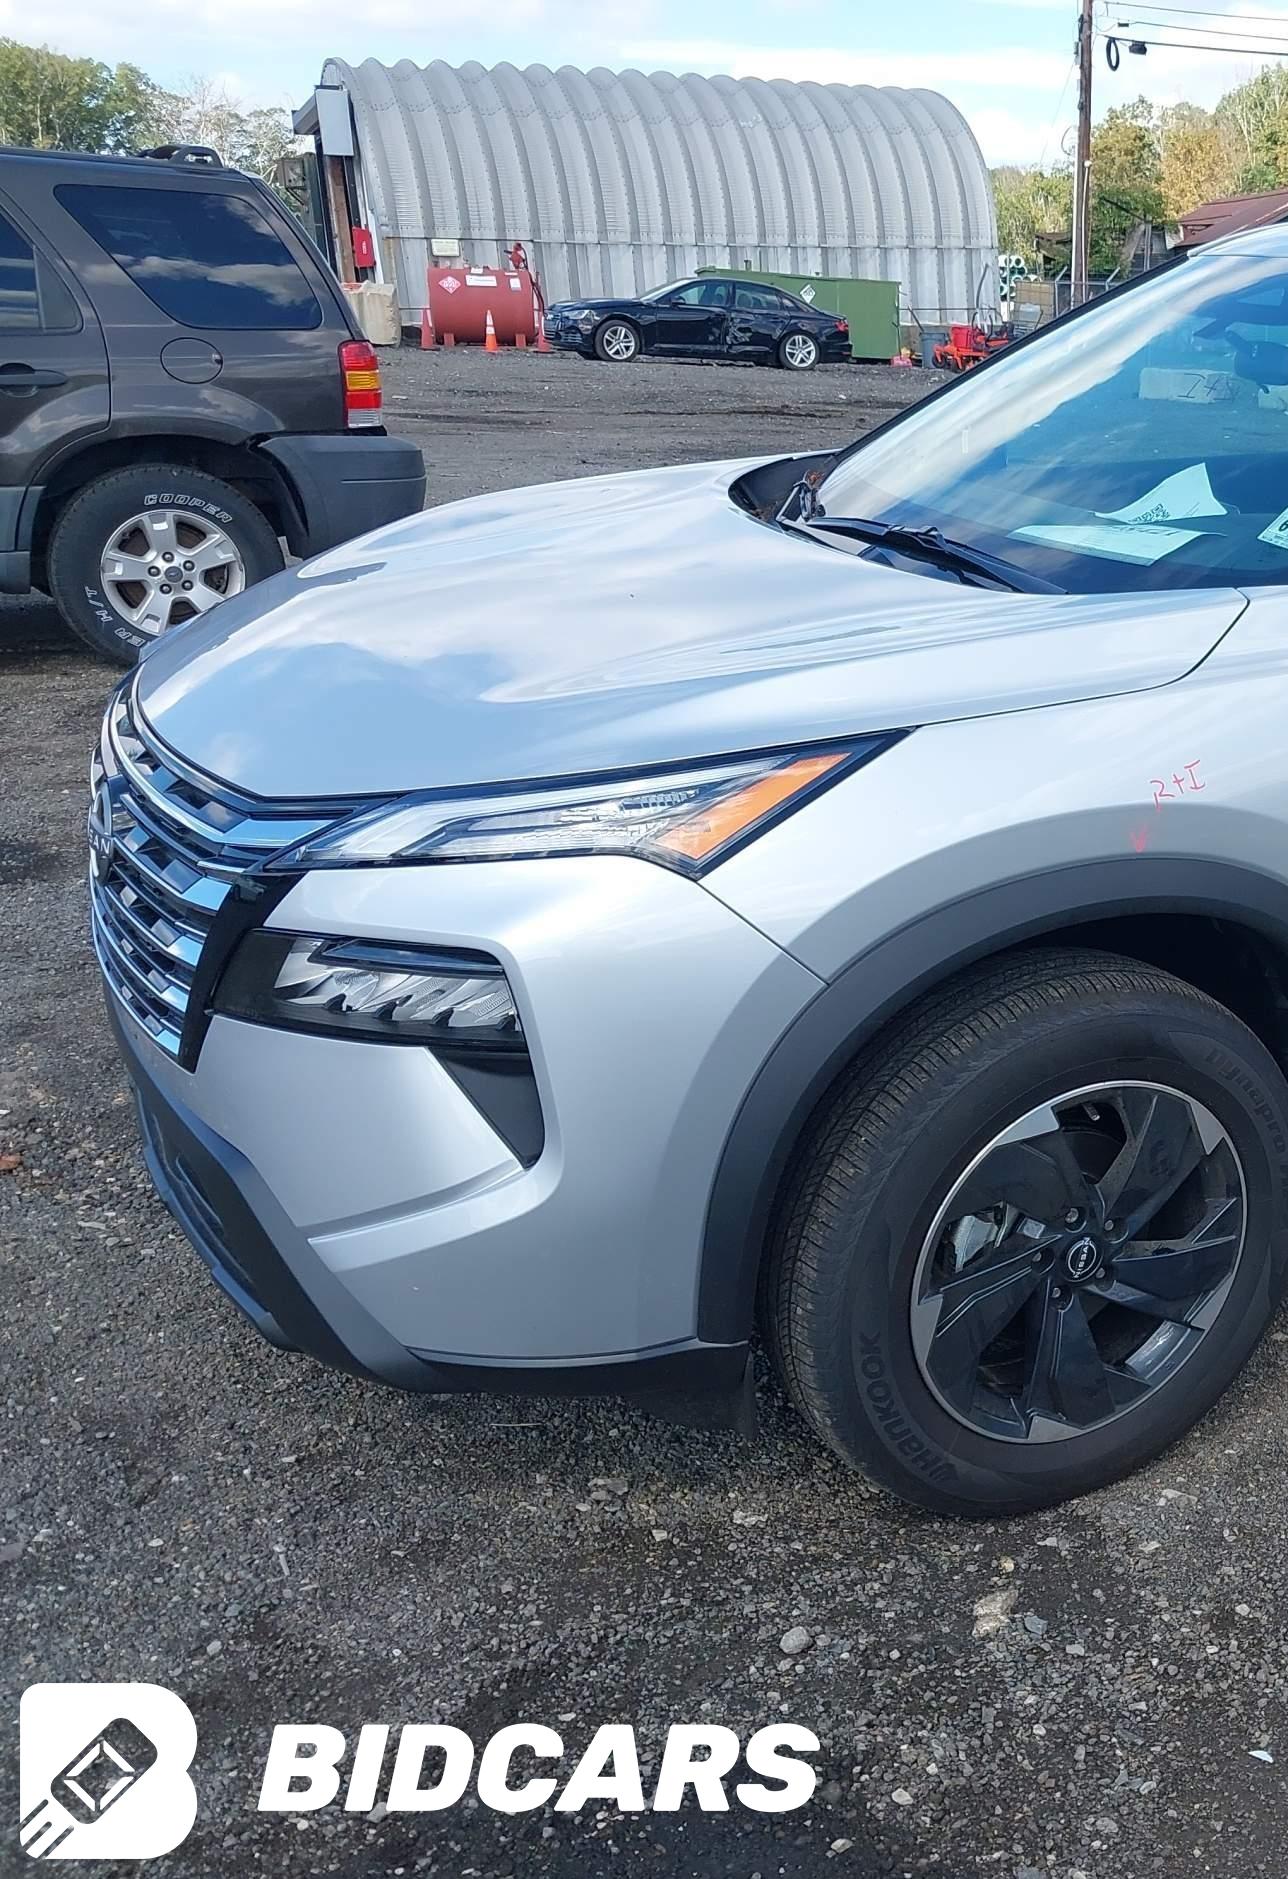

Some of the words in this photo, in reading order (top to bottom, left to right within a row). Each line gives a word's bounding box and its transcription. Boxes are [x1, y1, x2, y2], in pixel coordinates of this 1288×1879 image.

[144, 493, 233, 524] COOPER
[85, 585, 113, 623] H/T
[1073, 1236, 1091, 1279] NISSAN
